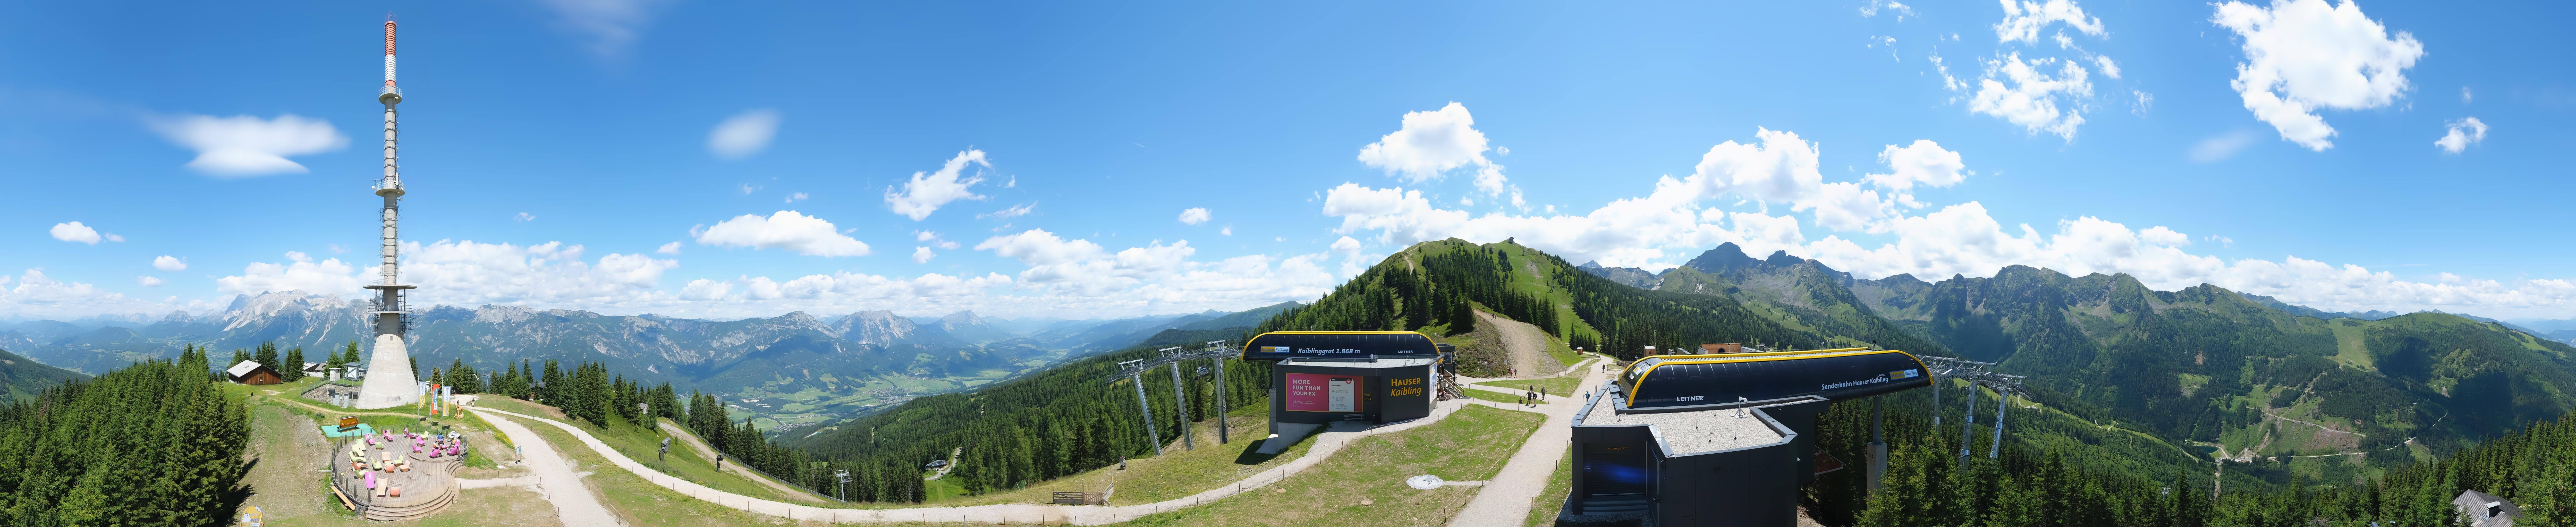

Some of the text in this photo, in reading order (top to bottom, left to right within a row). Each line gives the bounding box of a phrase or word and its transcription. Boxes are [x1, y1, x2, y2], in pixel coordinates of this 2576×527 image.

[1391, 378, 1421, 386] HAUSER
[1822, 381, 1852, 390] Senderbahn
[1391, 387, 1421, 396] Kaibling
